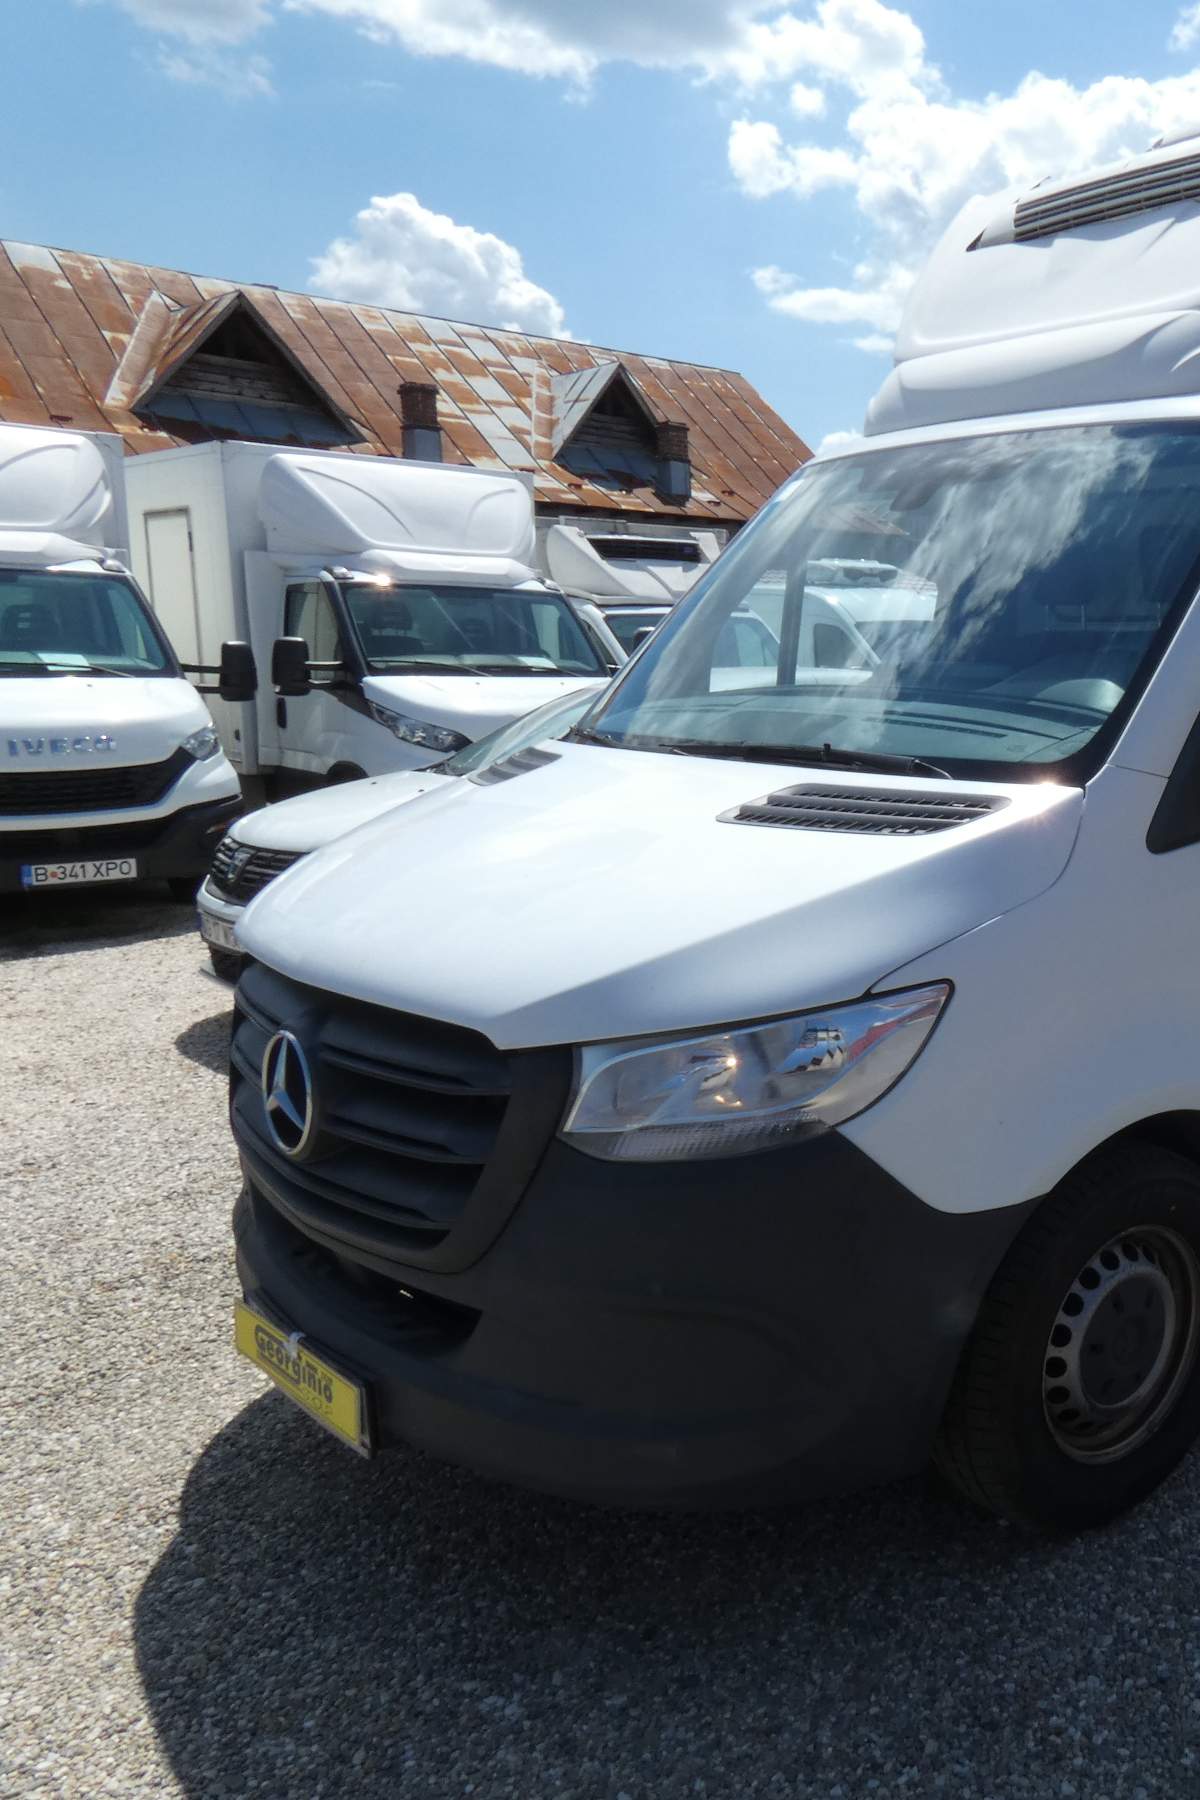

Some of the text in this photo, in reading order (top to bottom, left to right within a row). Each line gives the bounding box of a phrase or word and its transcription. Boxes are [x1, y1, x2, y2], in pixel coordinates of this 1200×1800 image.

[7, 735, 117, 757] IVECO
[34, 860, 132, 882] B 341 XPO
